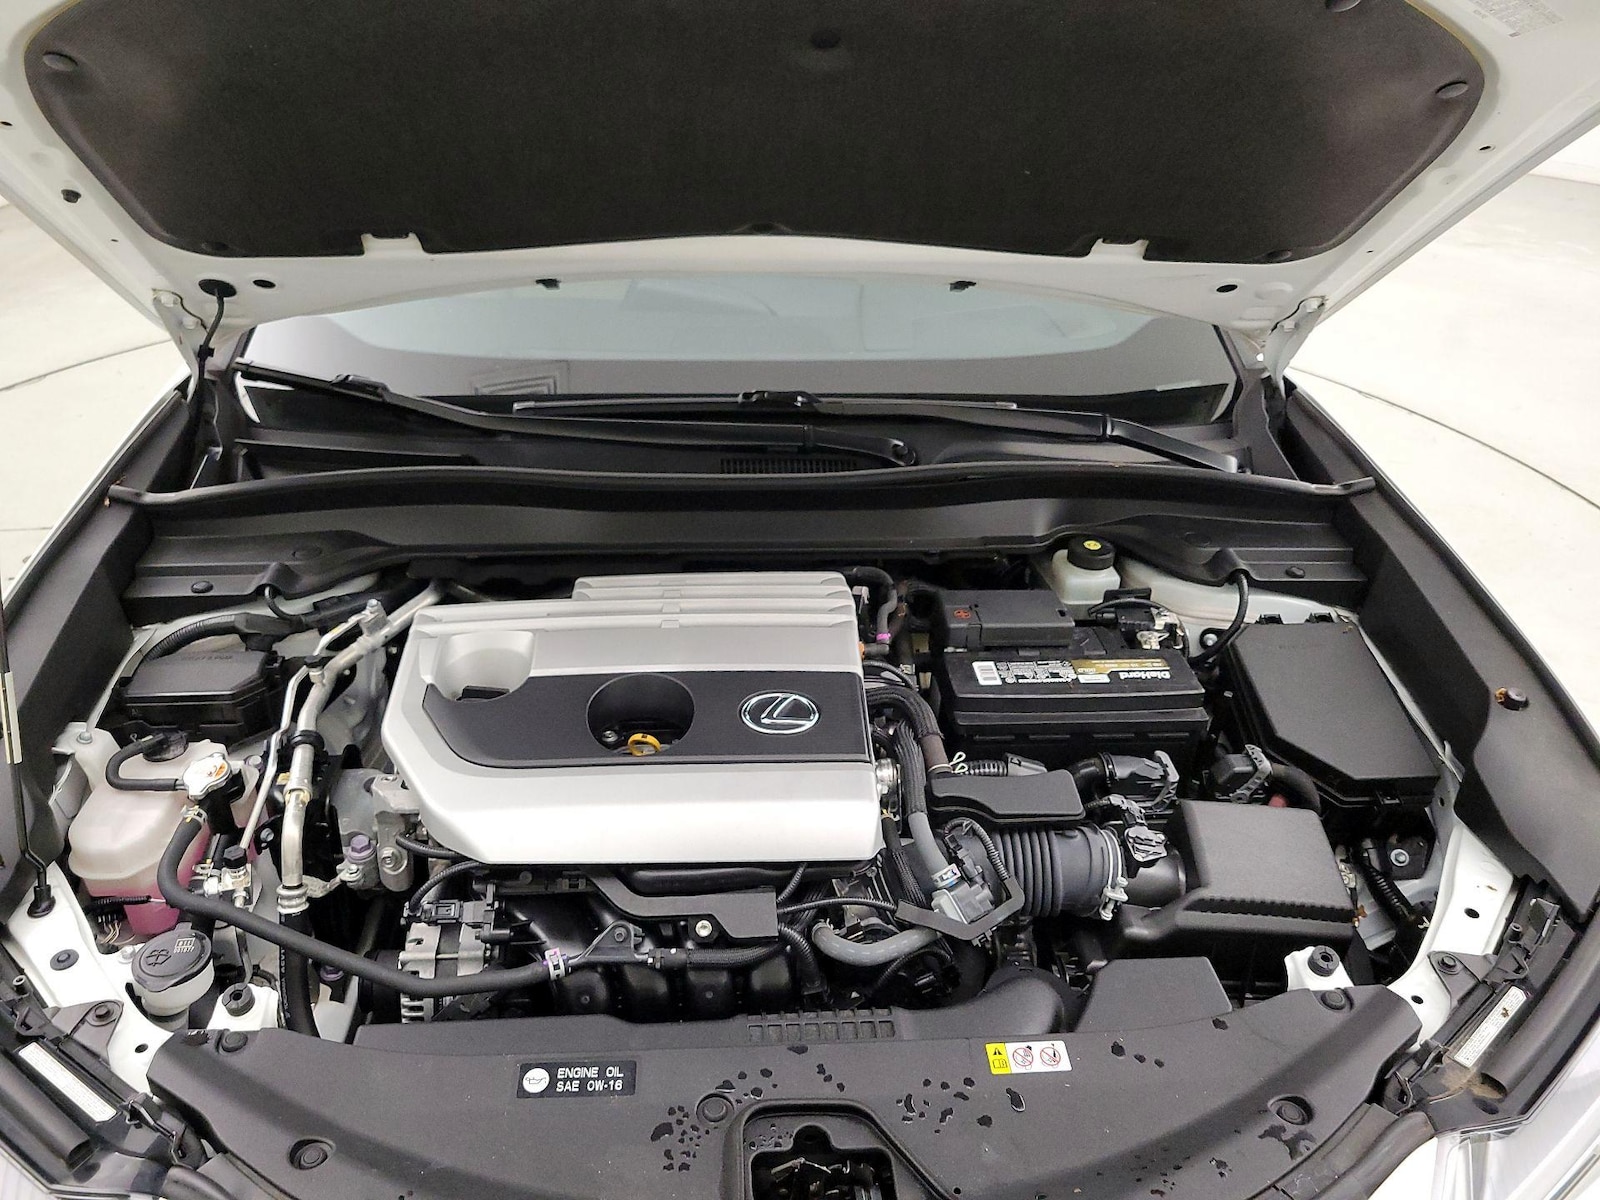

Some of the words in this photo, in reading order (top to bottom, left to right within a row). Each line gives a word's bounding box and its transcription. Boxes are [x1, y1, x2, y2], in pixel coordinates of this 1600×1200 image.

[1119, 670, 1171, 680] DieHard
[556, 1067, 599, 1079] ENGINE
[605, 1066, 625, 1078] OIL
[555, 1081, 580, 1093] SAE
[586, 1079, 623, 1092] 0W-16
